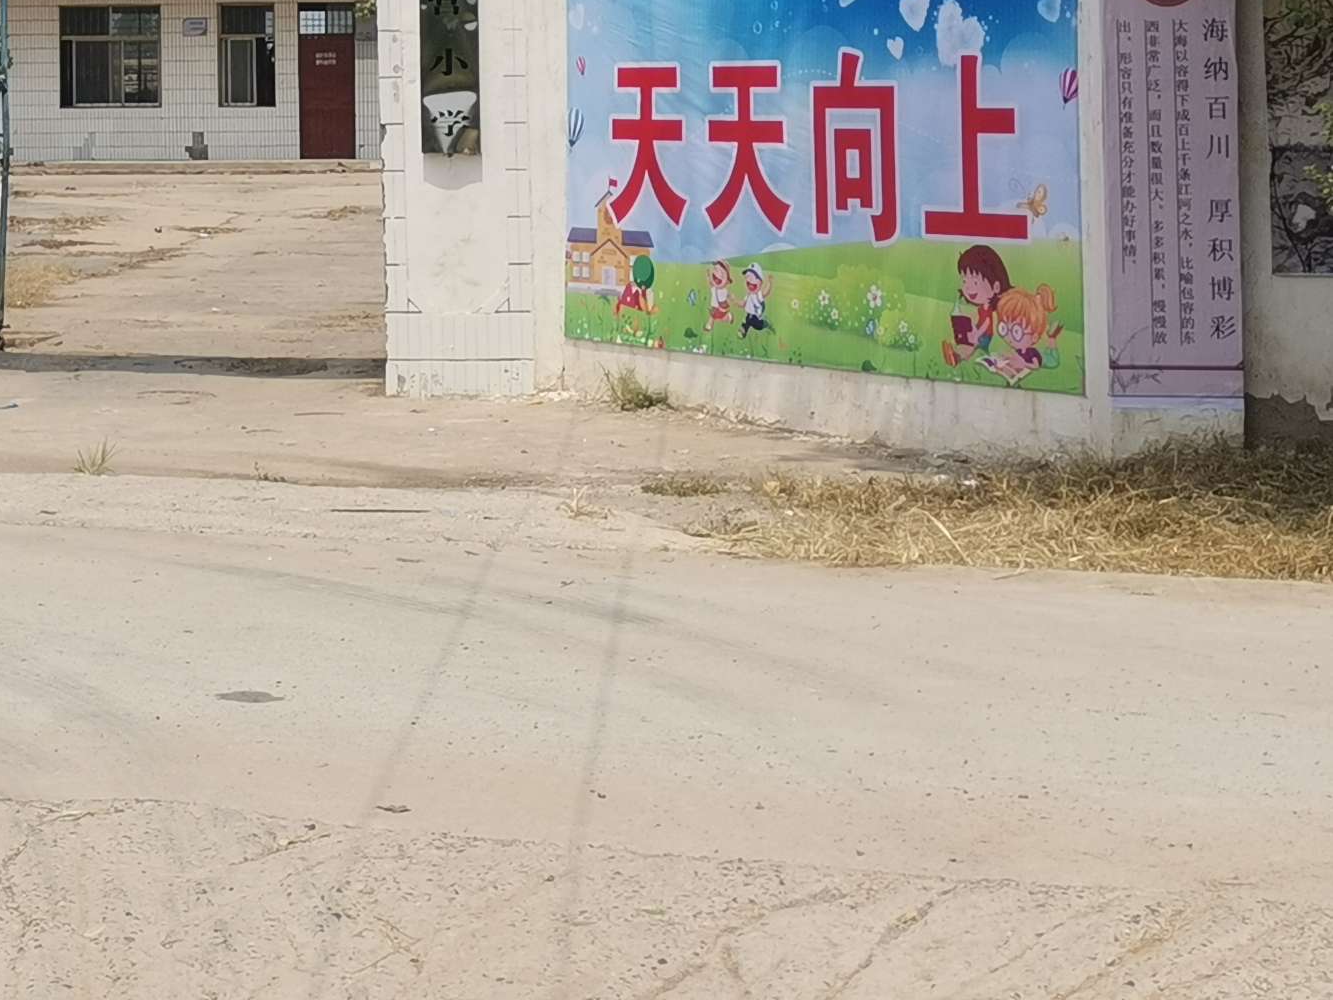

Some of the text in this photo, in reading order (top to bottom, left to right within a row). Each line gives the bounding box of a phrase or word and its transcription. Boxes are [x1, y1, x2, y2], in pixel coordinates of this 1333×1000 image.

[608, 49, 1030, 243] 天天向上
[1202, 17, 1237, 341] 海纳百川 厚积博彩
